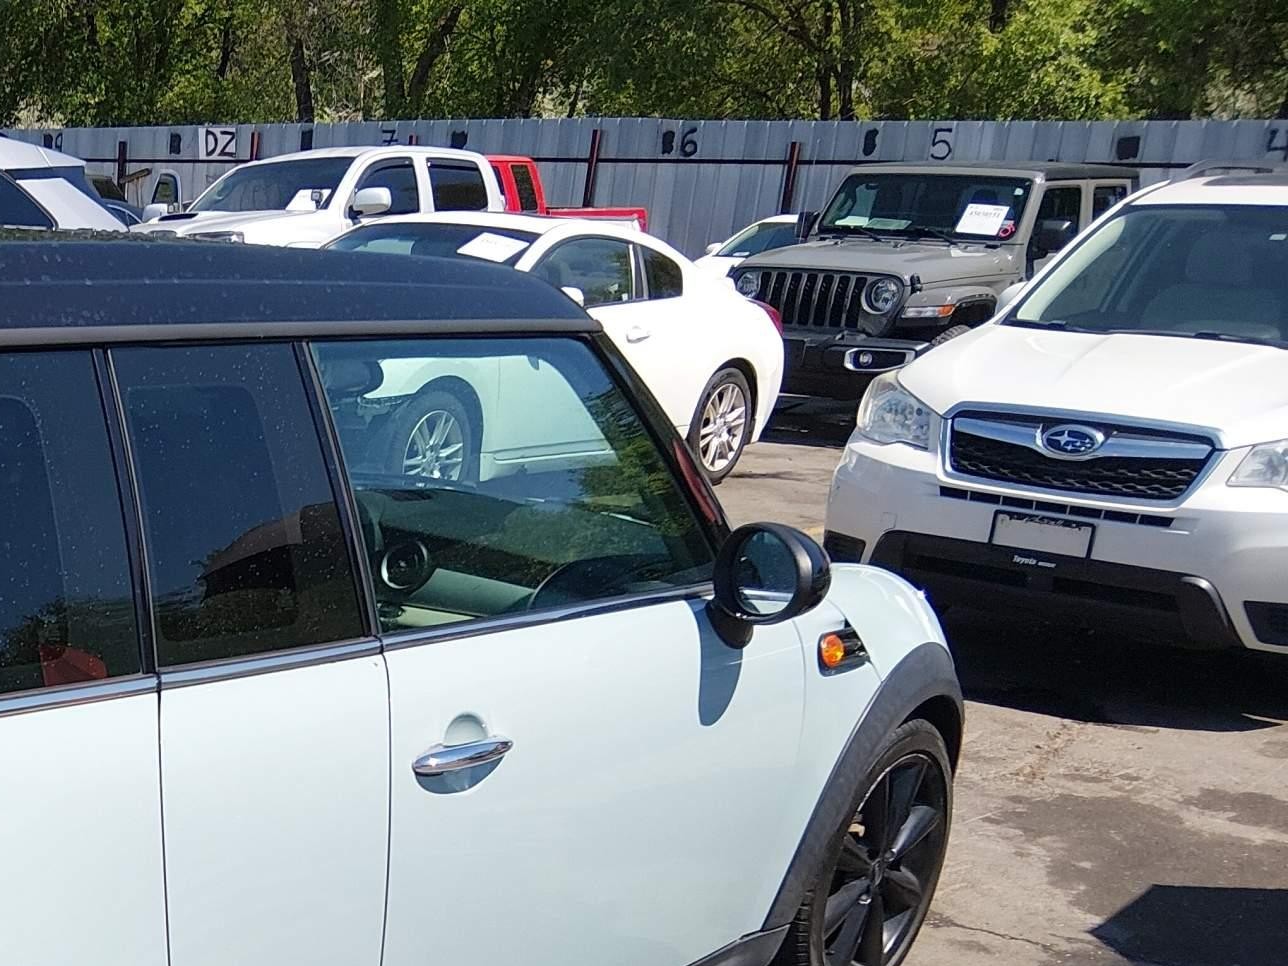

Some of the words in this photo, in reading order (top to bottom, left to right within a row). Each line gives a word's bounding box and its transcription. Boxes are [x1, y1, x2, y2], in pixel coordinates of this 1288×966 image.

[205, 129, 237, 158] DZ
[679, 127, 699, 158] 6
[930, 127, 954, 161] 5
[1266, 128, 1288, 162] 4
